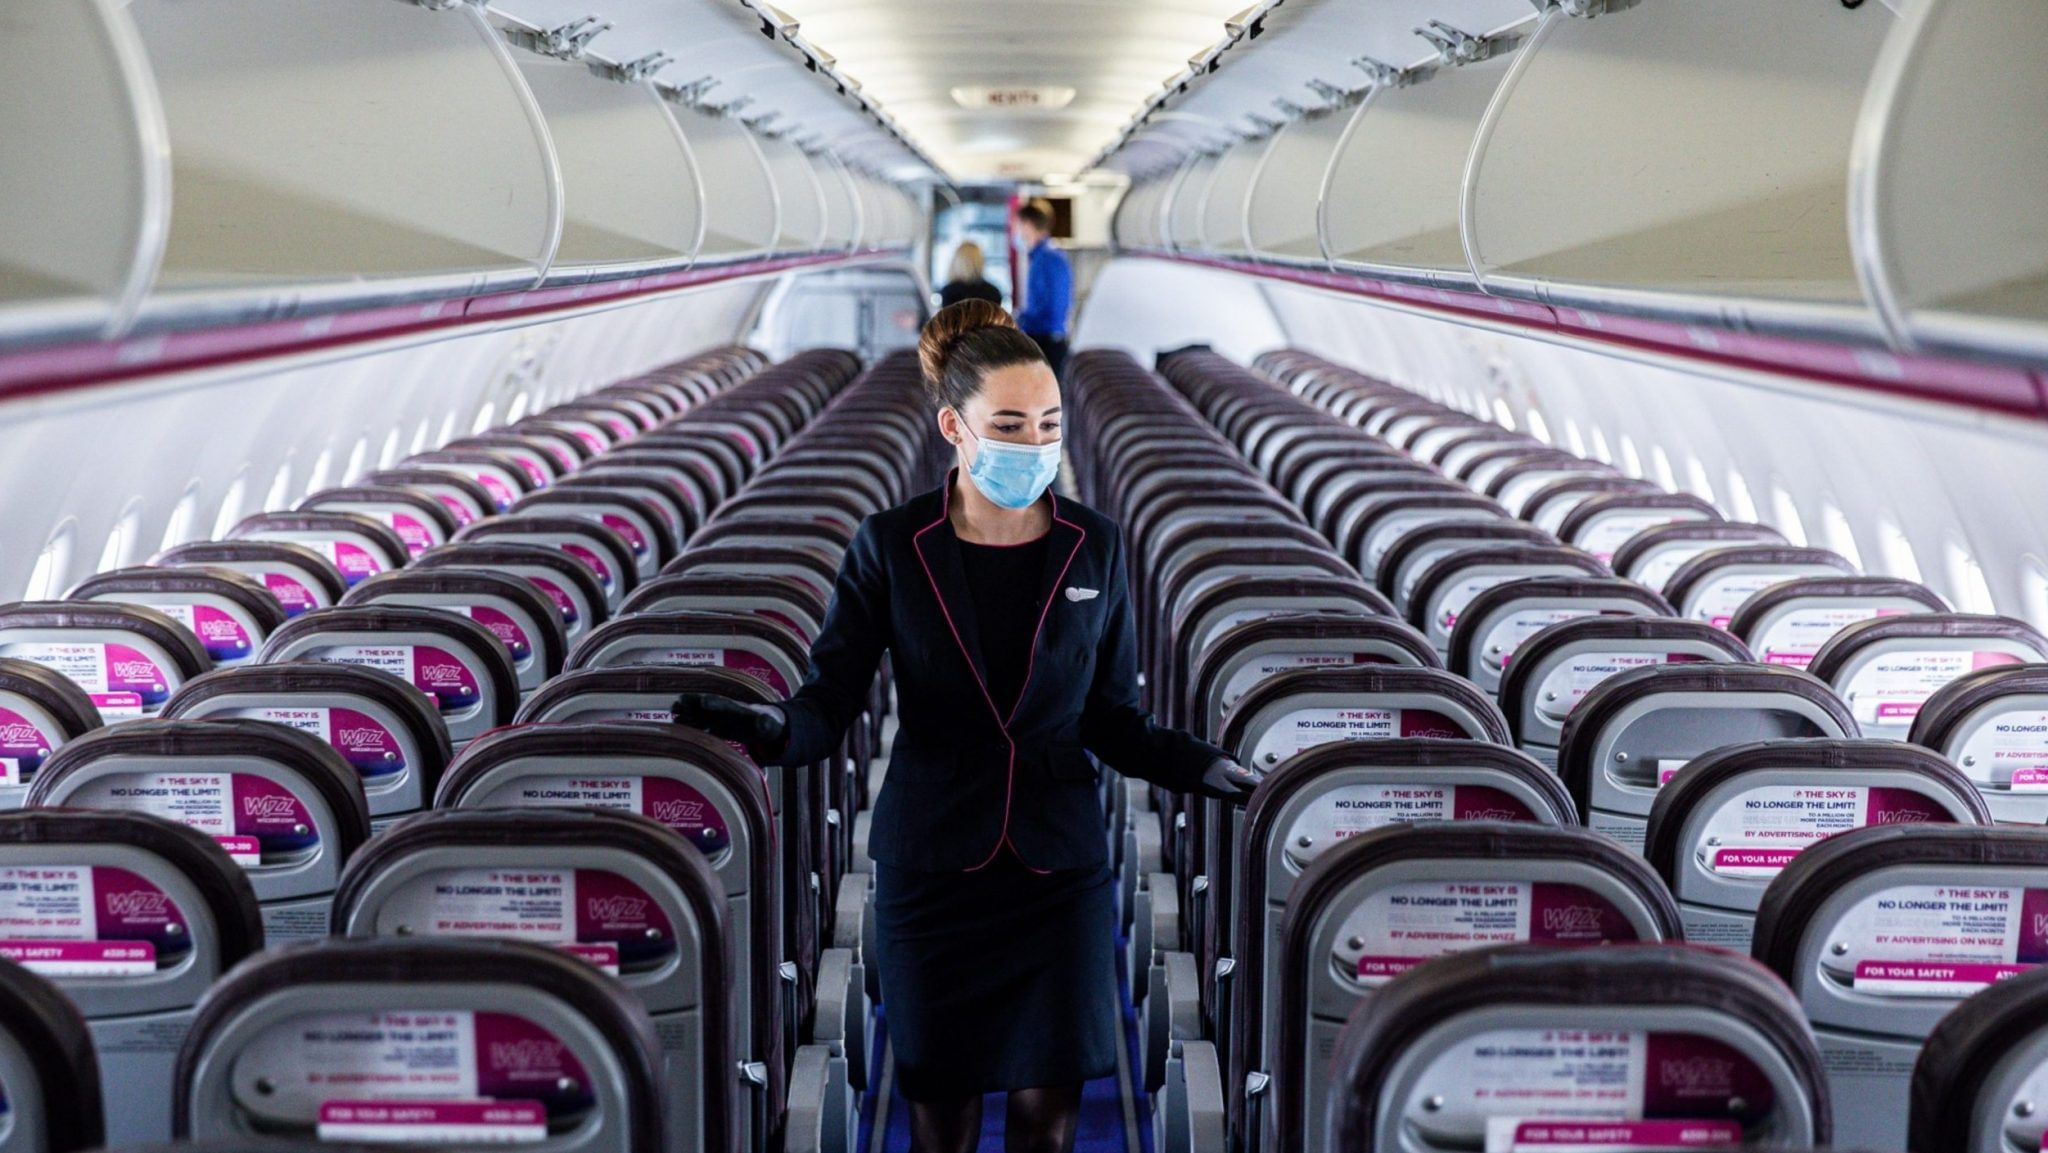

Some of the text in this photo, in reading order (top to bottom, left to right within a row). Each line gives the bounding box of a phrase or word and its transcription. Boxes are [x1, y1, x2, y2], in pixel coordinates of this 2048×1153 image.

[168, 777, 187, 785] THE
[541, 791, 579, 799] LONGER
[1352, 801, 1392, 809] LONGER
[1395, 801, 1413, 809] THE
[1763, 801, 1803, 809] LONGER
[1459, 886, 1518, 894] THE SKY IS
[1948, 889, 2009, 899] THE SKY IS
[1391, 897, 1408, 905] NO
[1411, 897, 1458, 906] LONGER
[1461, 898, 1482, 907] THE
[1878, 901, 2008, 911] NO LONGER THE LIMIT!
[1891, 936, 1957, 945] ADVERTISING
[1977, 938, 2003, 946] WIZZ
[1865, 967, 1955, 978] FOR YOUR SAFETY
